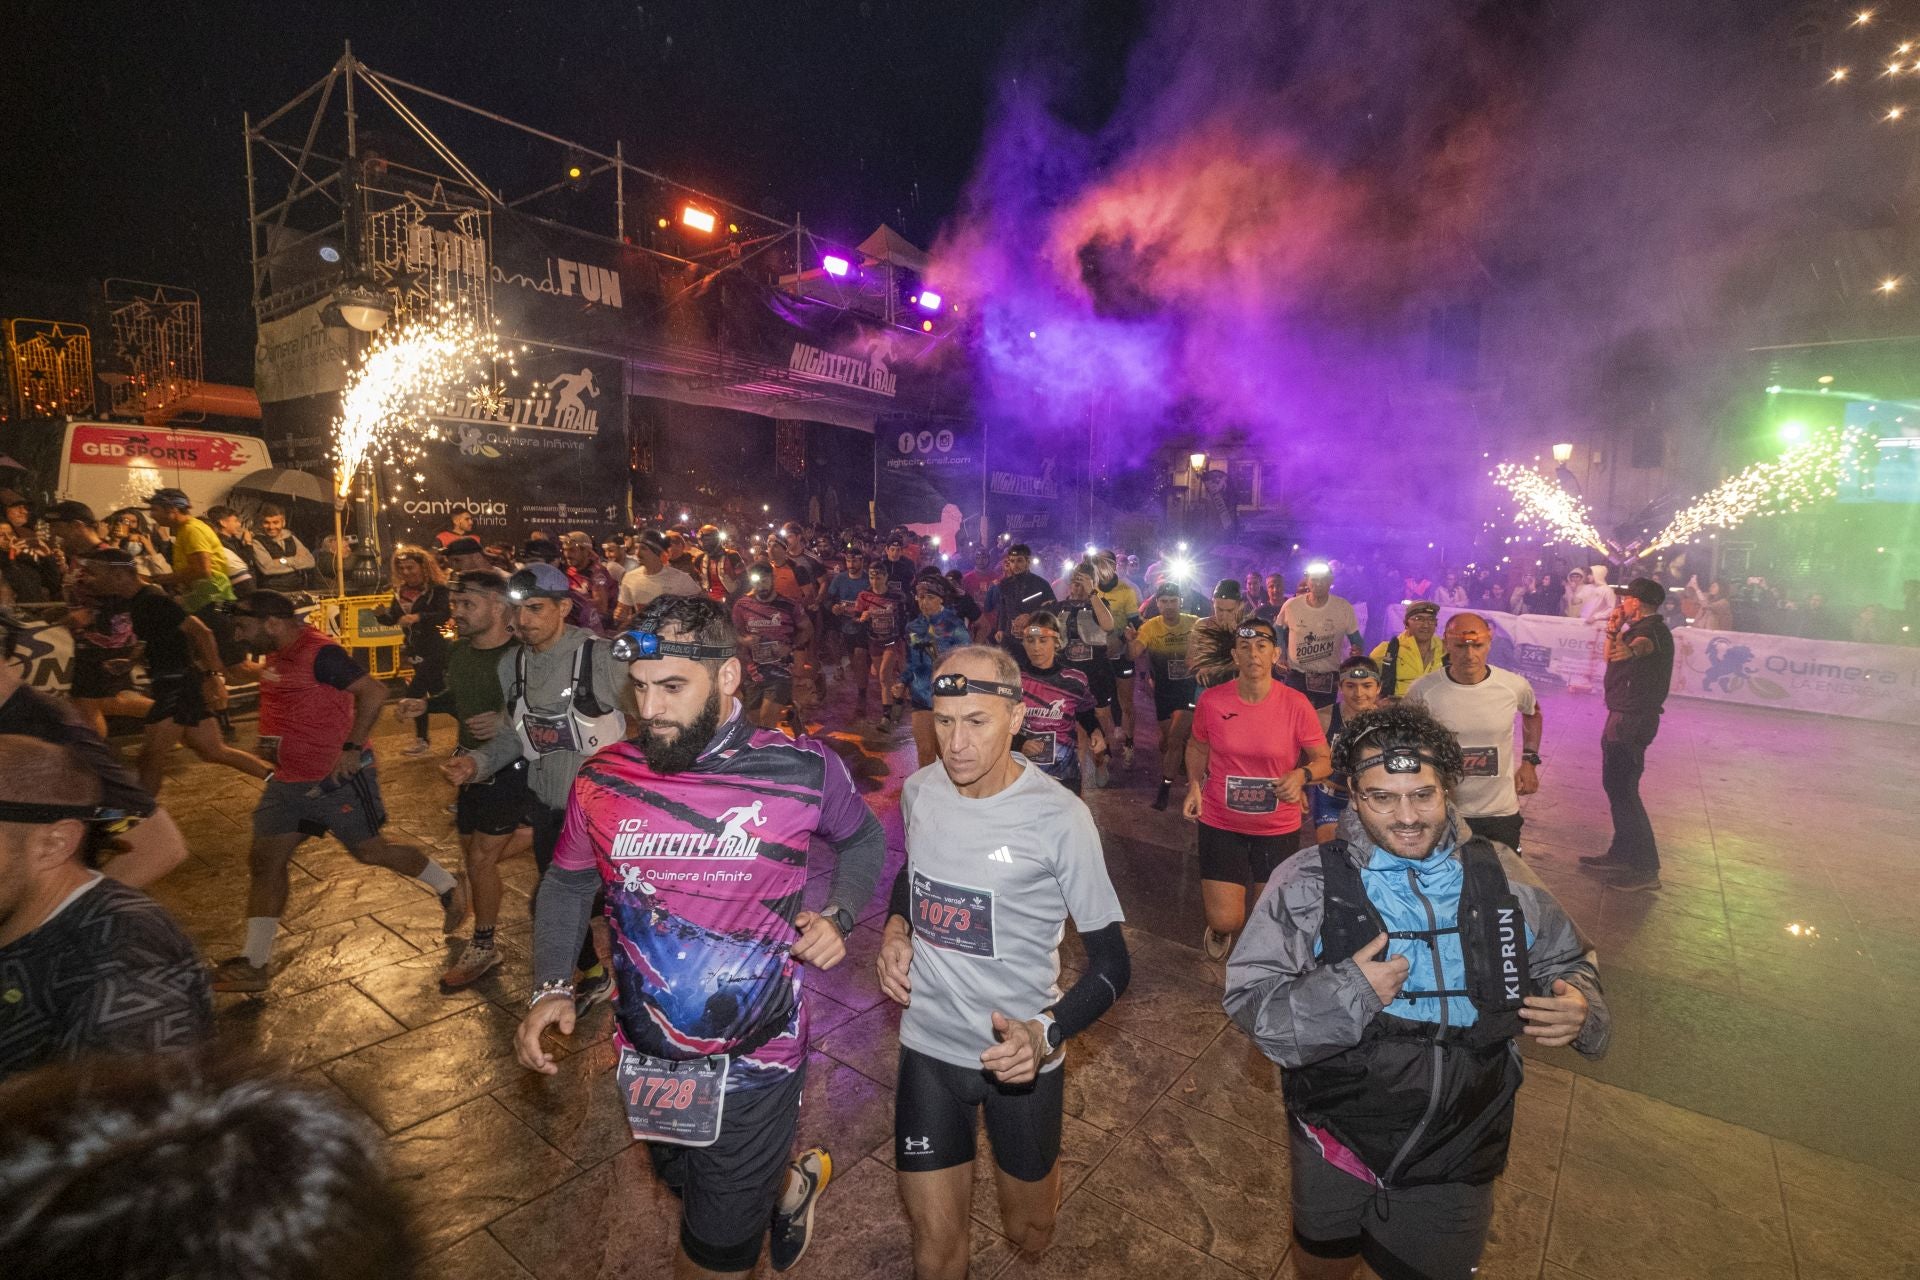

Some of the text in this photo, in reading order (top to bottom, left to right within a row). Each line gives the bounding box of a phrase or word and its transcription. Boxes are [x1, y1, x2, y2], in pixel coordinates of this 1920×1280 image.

[558, 258, 622, 308] FUN
[789, 342, 897, 394] NIGHTCITY TRAIL
[553, 404, 600, 432] TRAIL
[82, 442, 198, 461] GEDSPORTS
[403, 497, 506, 515] cantabria
[473, 515, 507, 526] nfinita
[1296, 641, 1334, 657] 2000KM
[1765, 655, 1898, 684] Quimera
[611, 833, 761, 857] NIGHTCITY TRAIL
[646, 869, 753, 883] Quimera Infinita
[919, 898, 971, 931] 1073
[1497, 908, 1521, 1000] KIPRUN
[628, 1075, 697, 1110] 1728
